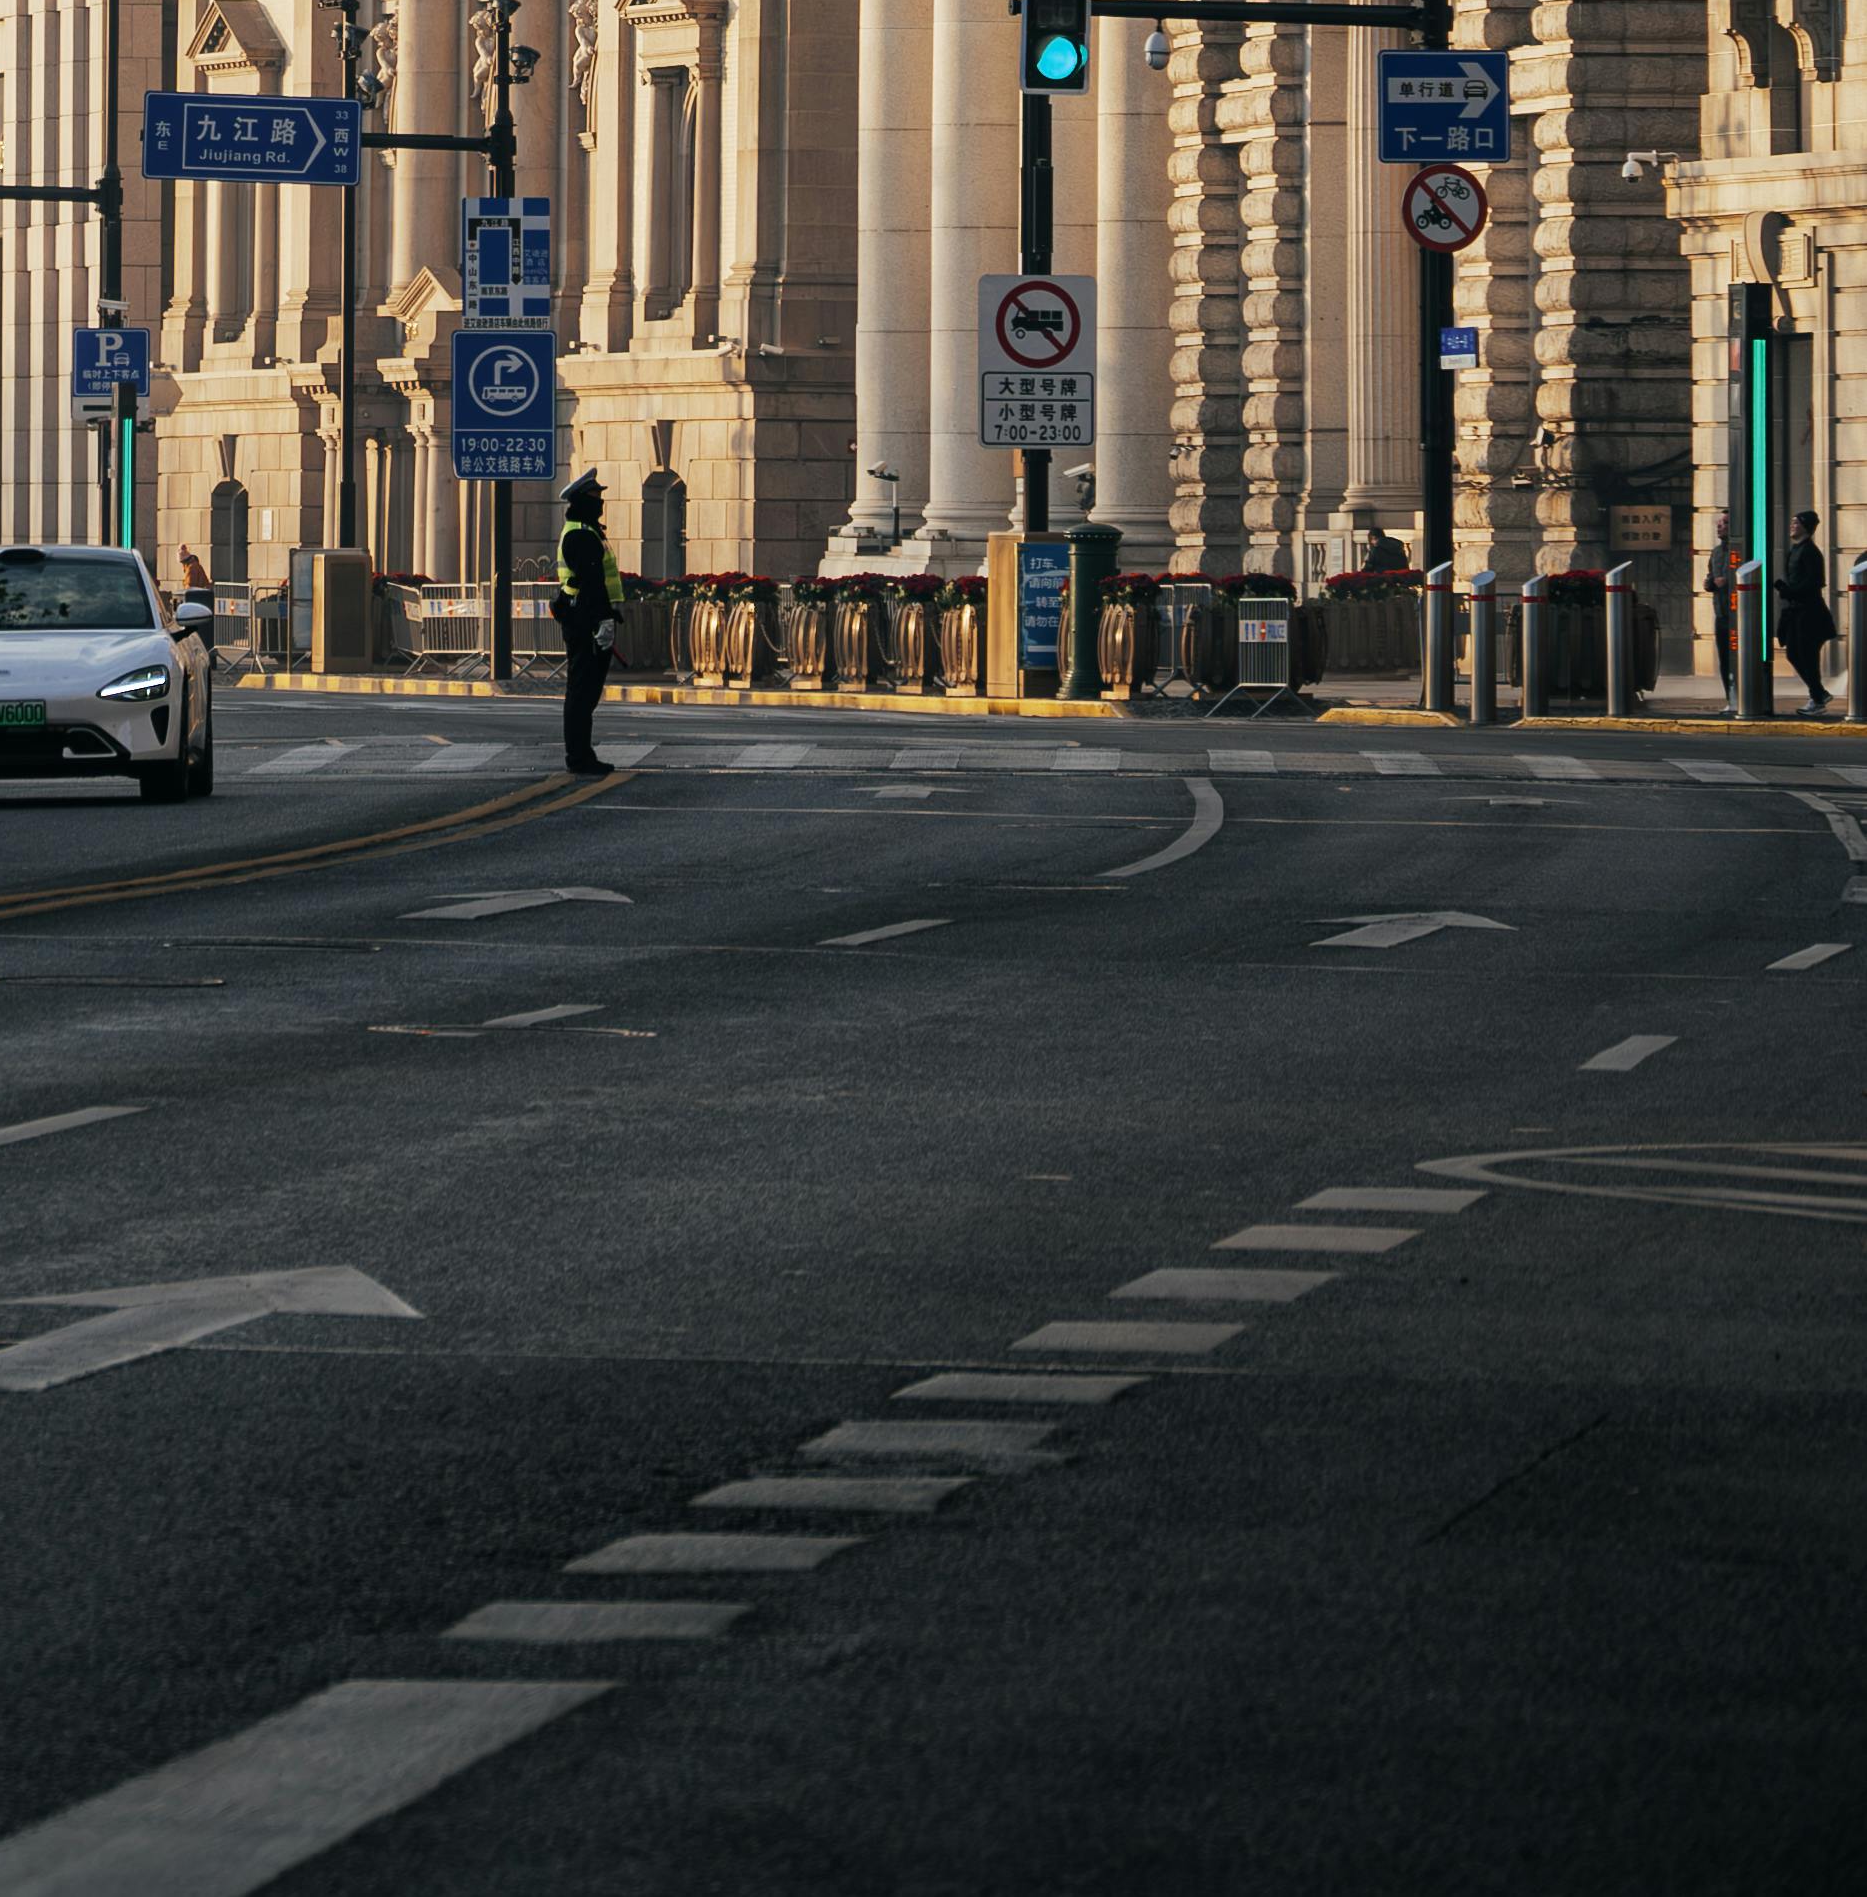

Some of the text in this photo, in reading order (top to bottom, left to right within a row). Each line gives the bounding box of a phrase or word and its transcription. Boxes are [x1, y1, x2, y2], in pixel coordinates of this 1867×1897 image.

[1399, 81, 1455, 98] 单行道
[335, 110, 349, 120] 33
[155, 120, 171, 138] 东
[196, 114, 297, 146] 九江路
[334, 128, 350, 144] 西
[158, 141, 168, 150] E
[1394, 125, 1494, 152] 下一路口
[199, 148, 291, 165] Jiujiang Rd.
[333, 147, 349, 157] W
[334, 164, 347, 174] 38
[468, 254, 478, 310] 中山东一路
[95, 332, 124, 367] P
[998, 376, 1078, 396] 大型号牌
[998, 403, 1078, 422] 小型号牌
[994, 424, 1082, 441] 7:00-23:00
[461, 437, 547, 452] 19:00-22:30
[460, 455, 546, 474] 除公交线路车外
